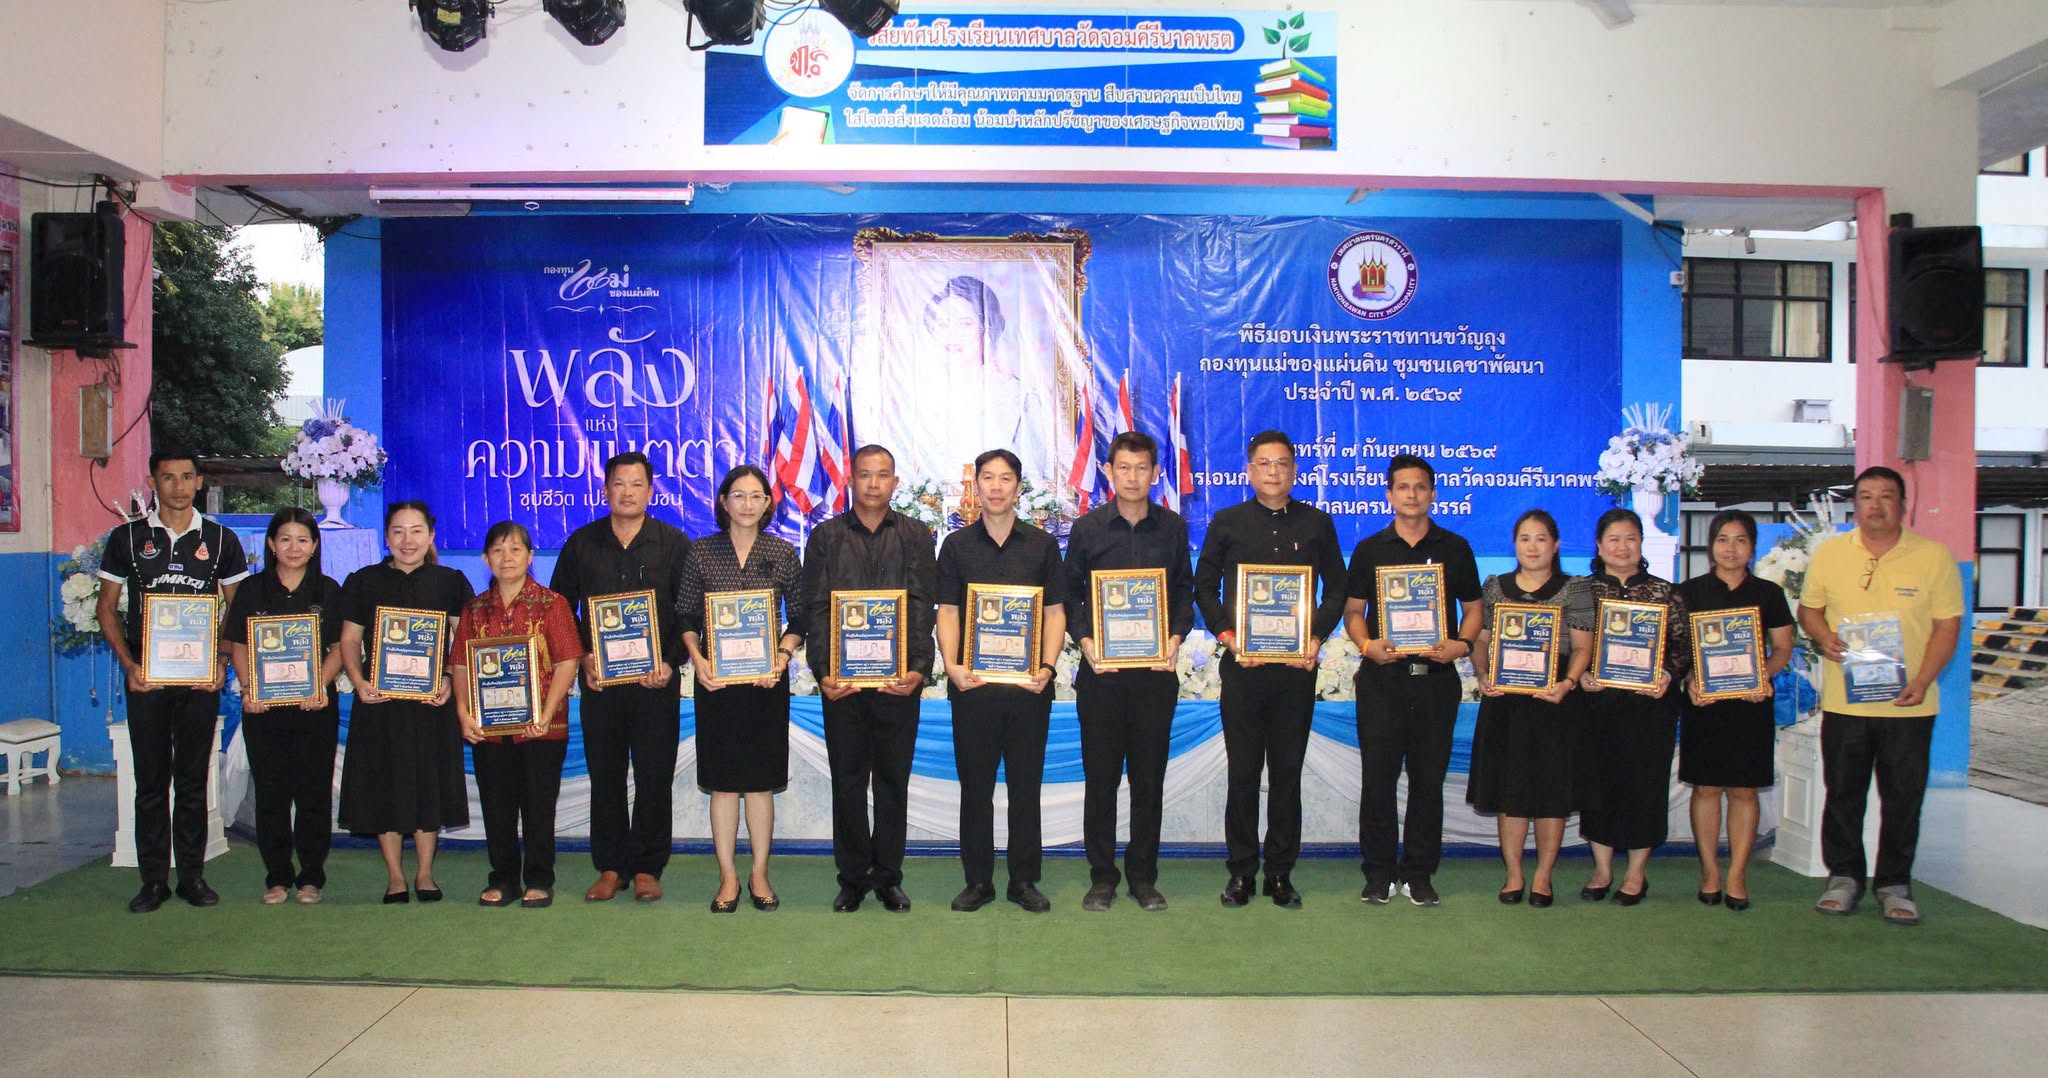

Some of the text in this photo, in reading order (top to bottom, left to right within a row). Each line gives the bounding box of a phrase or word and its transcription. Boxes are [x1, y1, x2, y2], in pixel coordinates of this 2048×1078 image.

[1104, 83, 1241, 104] สืบสานความเป็นไทย
[844, 106, 1244, 134] ใส่ใจต่อสิ่งแวดล้อม น้อมนำหลักปรัชญาของเศรษฐกิจพอเพียง
[543, 266, 574, 278] กองทุน
[608, 287, 660, 298] ของแผ่นดิน
[1386, 278, 1416, 315] MUNICIPALITY
[1238, 322, 1507, 352] พิธีมอบเงินพระราชทานขวัญถุง
[509, 326, 696, 408] พลัง
[1199, 352, 1544, 380] กองทุนแม่ของแผ่นดิน ชุมชนเดชาพัฒนา
[1284, 380, 1463, 401] ประจำปี พ.ศ. ๒๕๖๙
[585, 414, 618, 432] แห่ง
[1341, 444, 1359, 458] ๗
[1362, 437, 1436, 458] กันยายน
[1440, 444, 1497, 459] ๒๕๖๙
[519, 489, 575, 511] ชุบชีวิต
